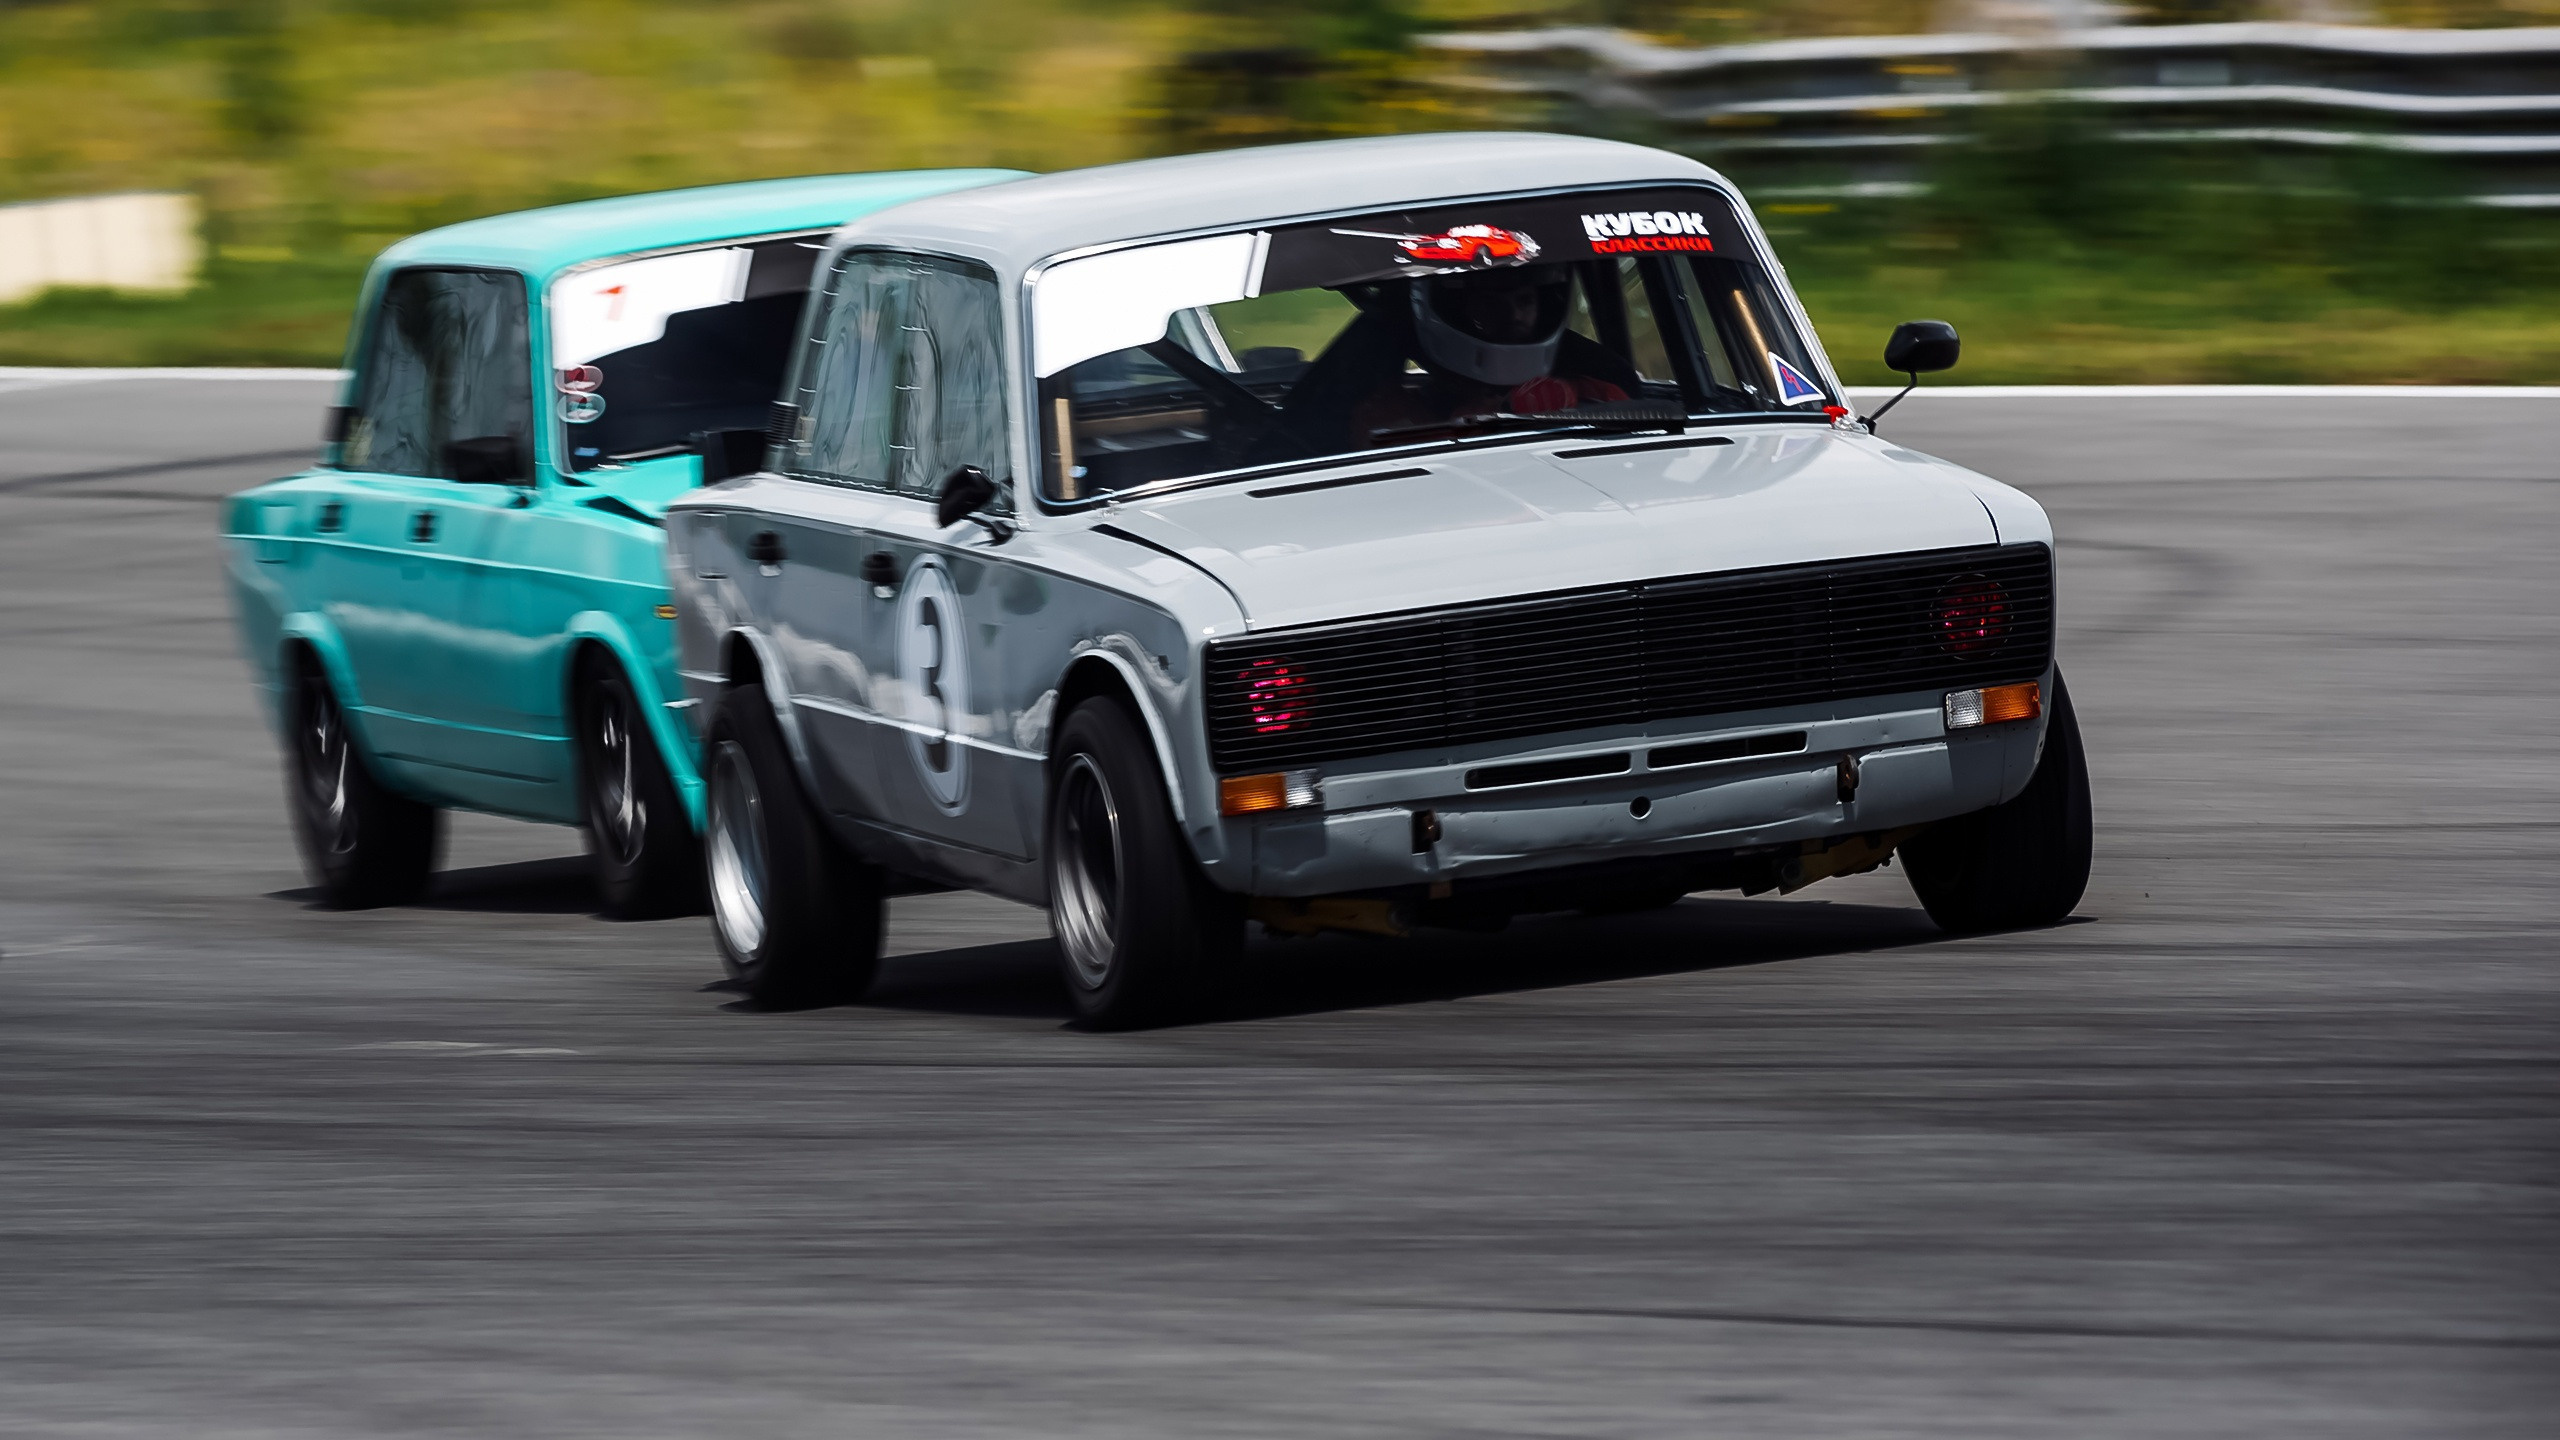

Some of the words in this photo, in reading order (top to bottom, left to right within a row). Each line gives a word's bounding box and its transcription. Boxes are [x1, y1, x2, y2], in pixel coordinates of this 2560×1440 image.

[1580, 211, 1710, 240] КУБОК
[1590, 236, 1714, 254] КЛАССИКИ
[917, 596, 951, 774] 3
